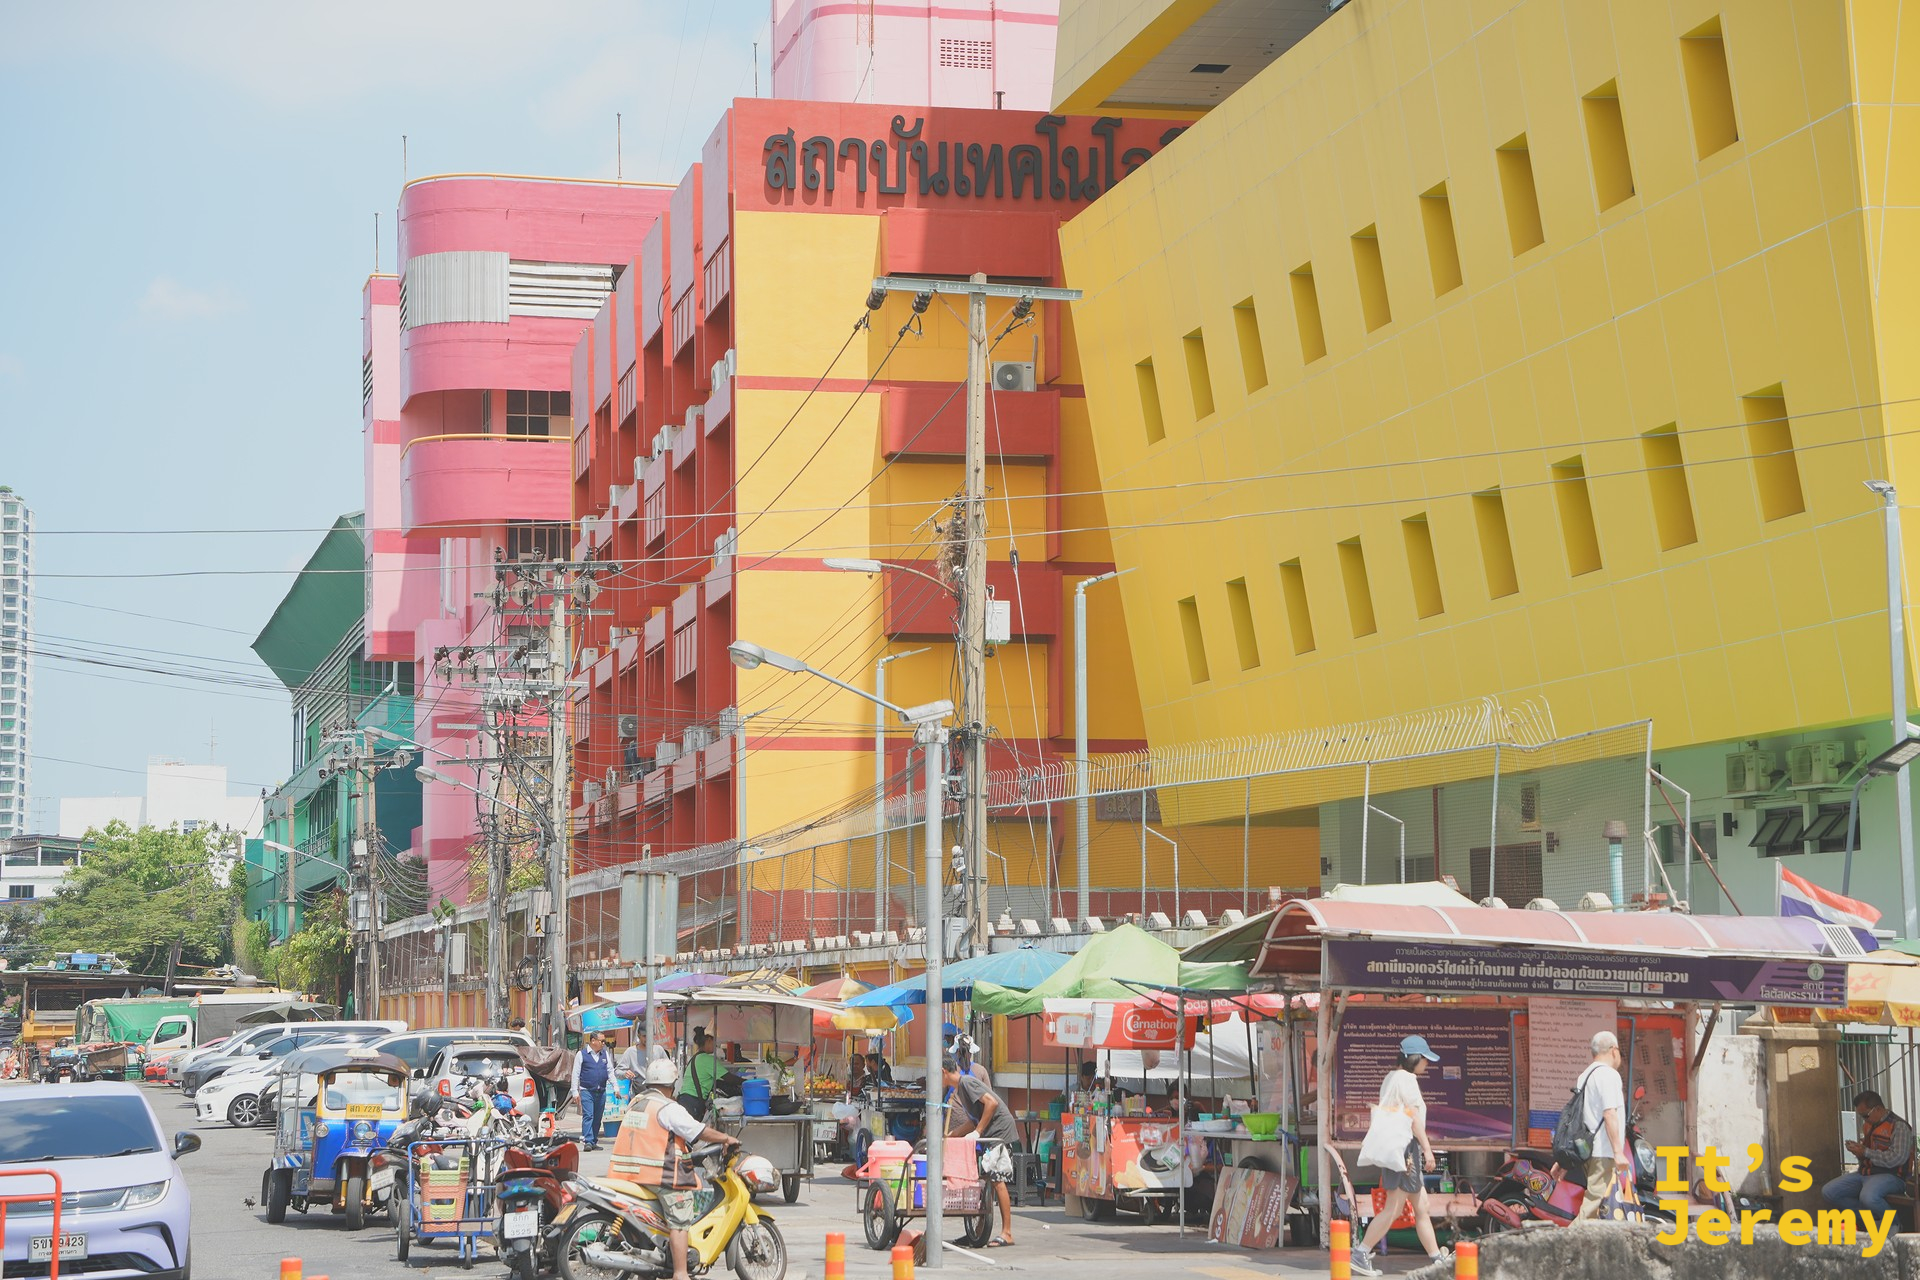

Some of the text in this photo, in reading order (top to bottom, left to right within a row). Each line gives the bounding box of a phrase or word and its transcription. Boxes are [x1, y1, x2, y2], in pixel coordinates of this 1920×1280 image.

[1126, 1014, 1177, 1032] Carnation
[363, 1105, 381, 1113] 7278
[510, 1228, 532, 1237] 3525
